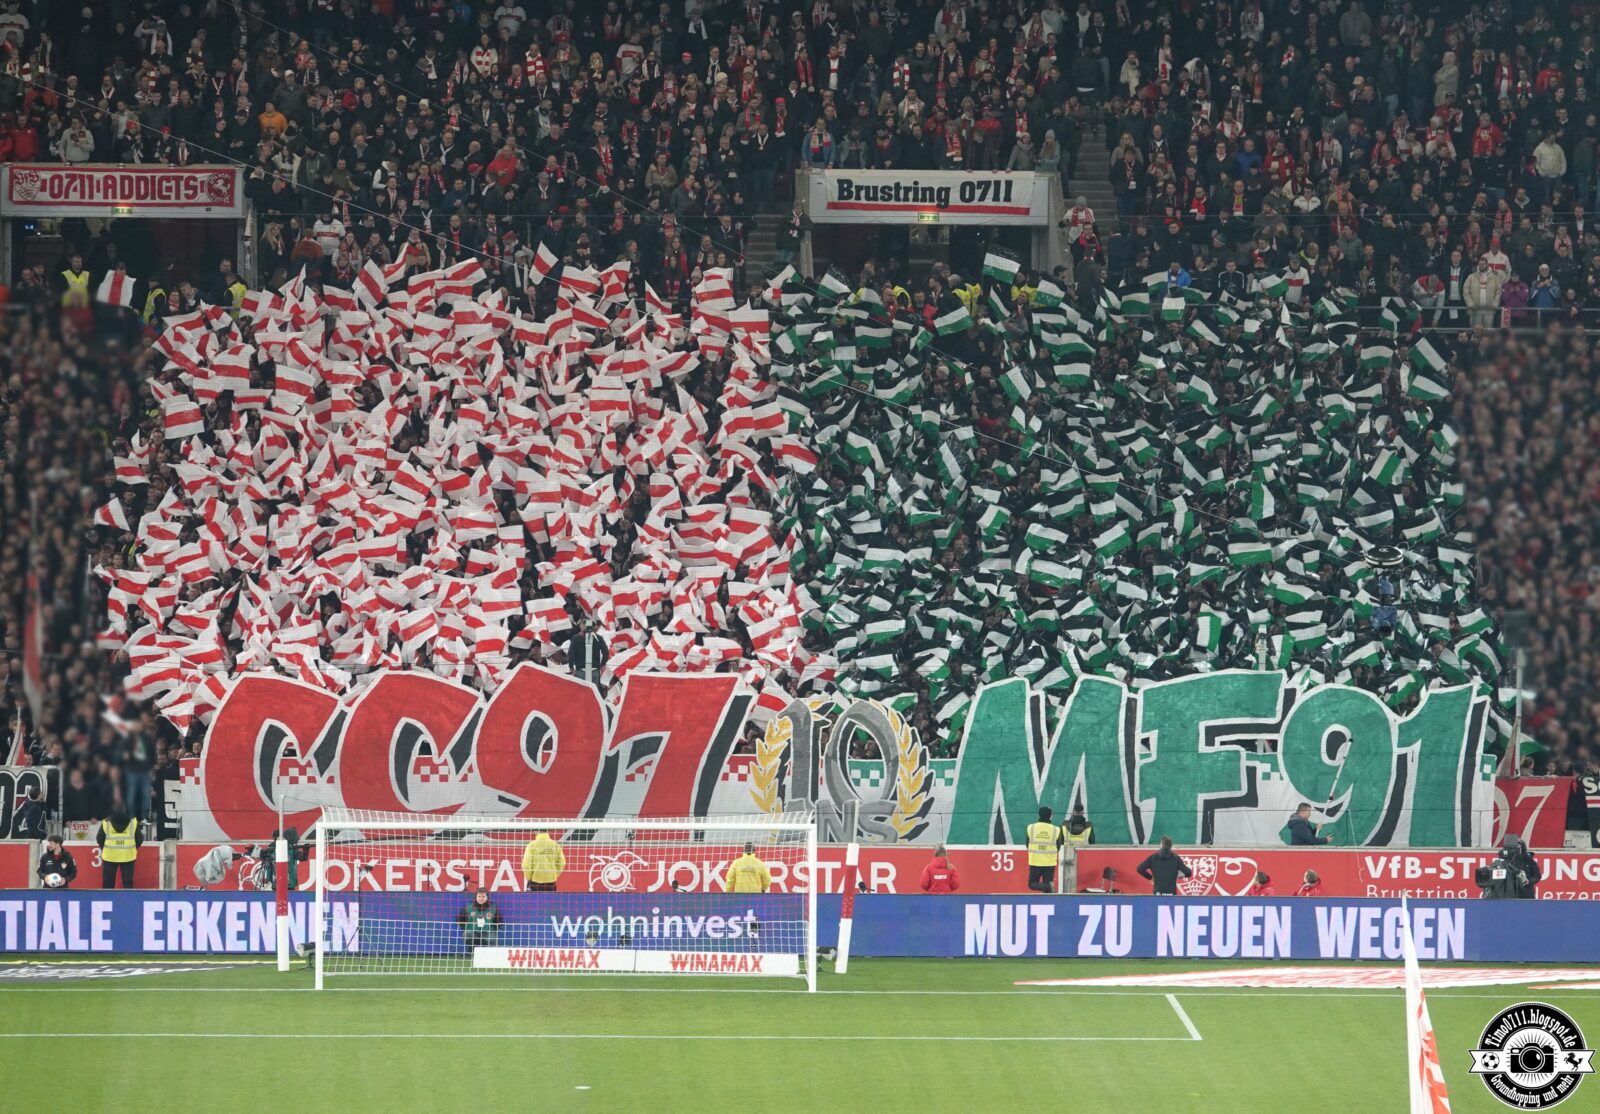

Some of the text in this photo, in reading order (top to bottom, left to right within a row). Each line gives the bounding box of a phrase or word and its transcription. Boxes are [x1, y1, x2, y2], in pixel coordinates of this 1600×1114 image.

[837, 179, 1013, 209] Brustring 0711
[203, 663, 752, 840] CC97
[948, 669, 1490, 846] MF91
[298, 858, 528, 891] JOKERSTA
[648, 861, 897, 893] JOKRSTAR
[990, 851, 1014, 871] 35
[1366, 884, 1468, 899] Brustring
[0, 901, 360, 952] TIALE ERKENNEN
[551, 906, 758, 938] wohninvest
[965, 904, 1465, 959] MUT ZU NEUEN WEGEN
[507, 949, 600, 968] WINAMAX
[670, 953, 763, 973] WINAMAX
